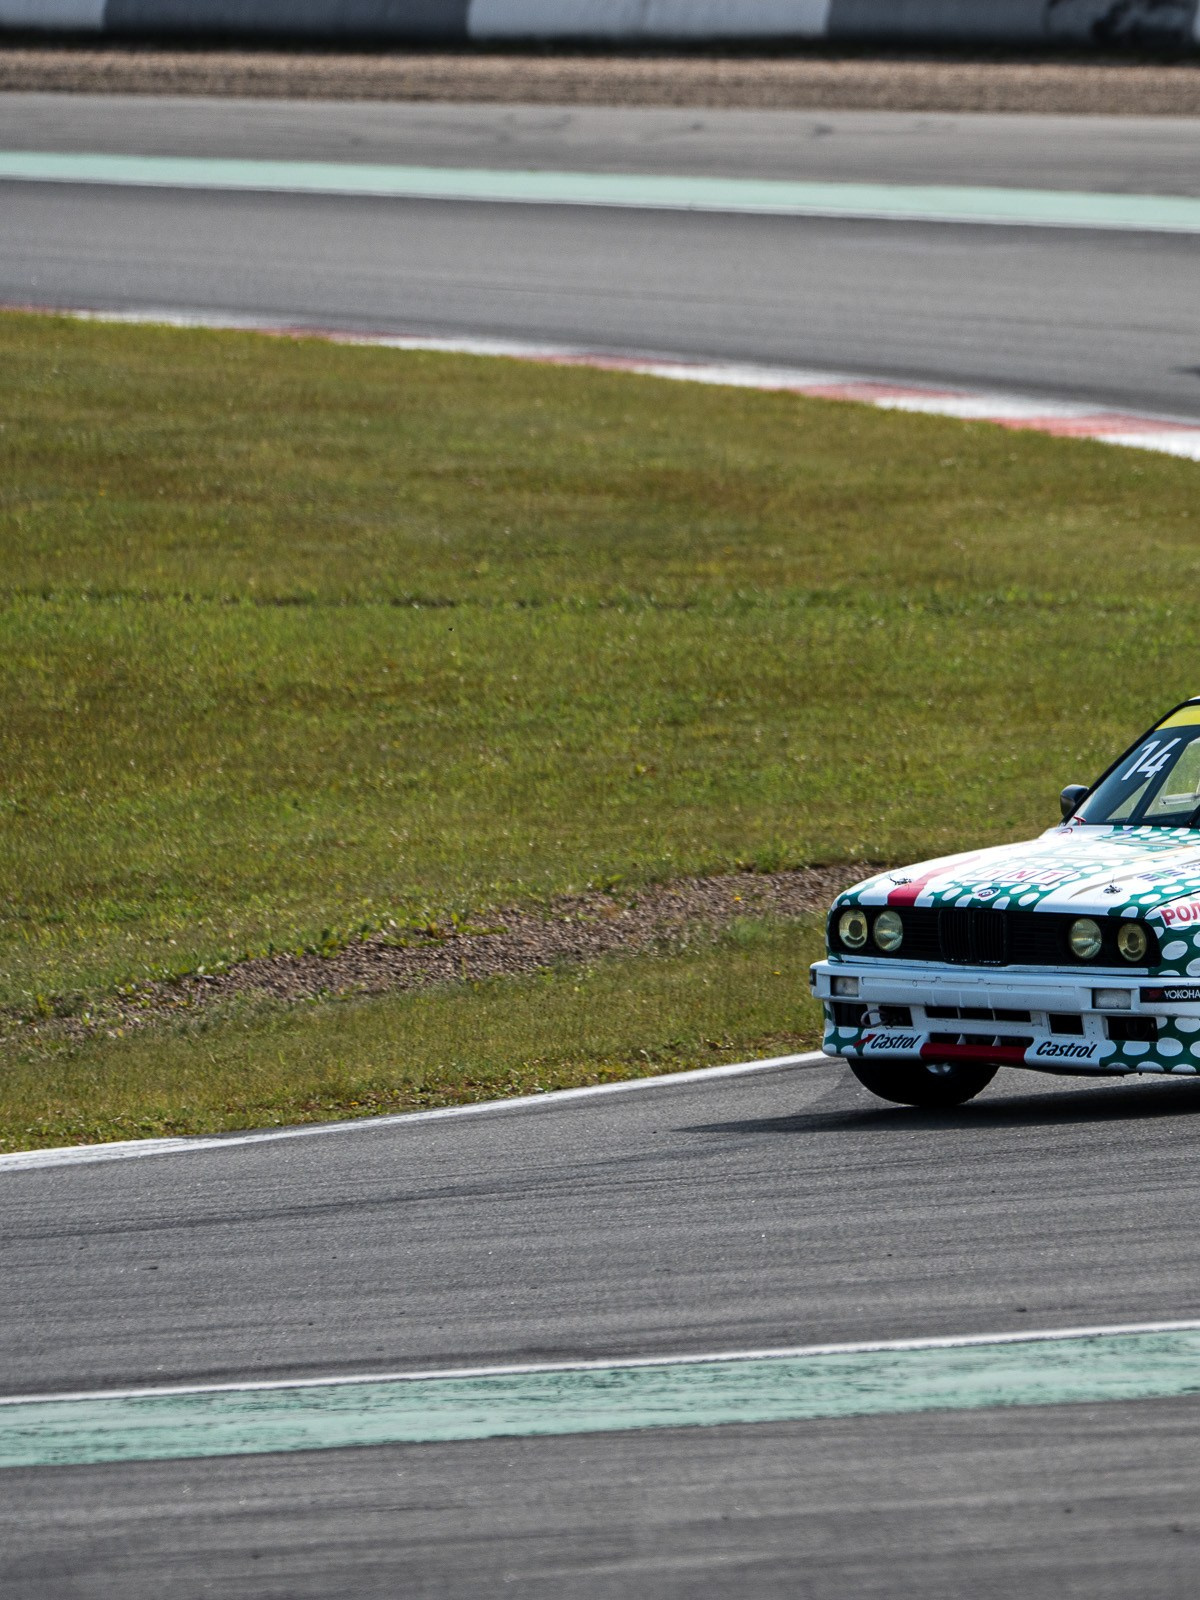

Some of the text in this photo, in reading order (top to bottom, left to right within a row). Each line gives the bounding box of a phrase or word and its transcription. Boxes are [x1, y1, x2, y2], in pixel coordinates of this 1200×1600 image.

[1121, 737, 1182, 781] 14
[870, 1034, 922, 1051] Castrol
[1036, 1041, 1098, 1059] Castrol
